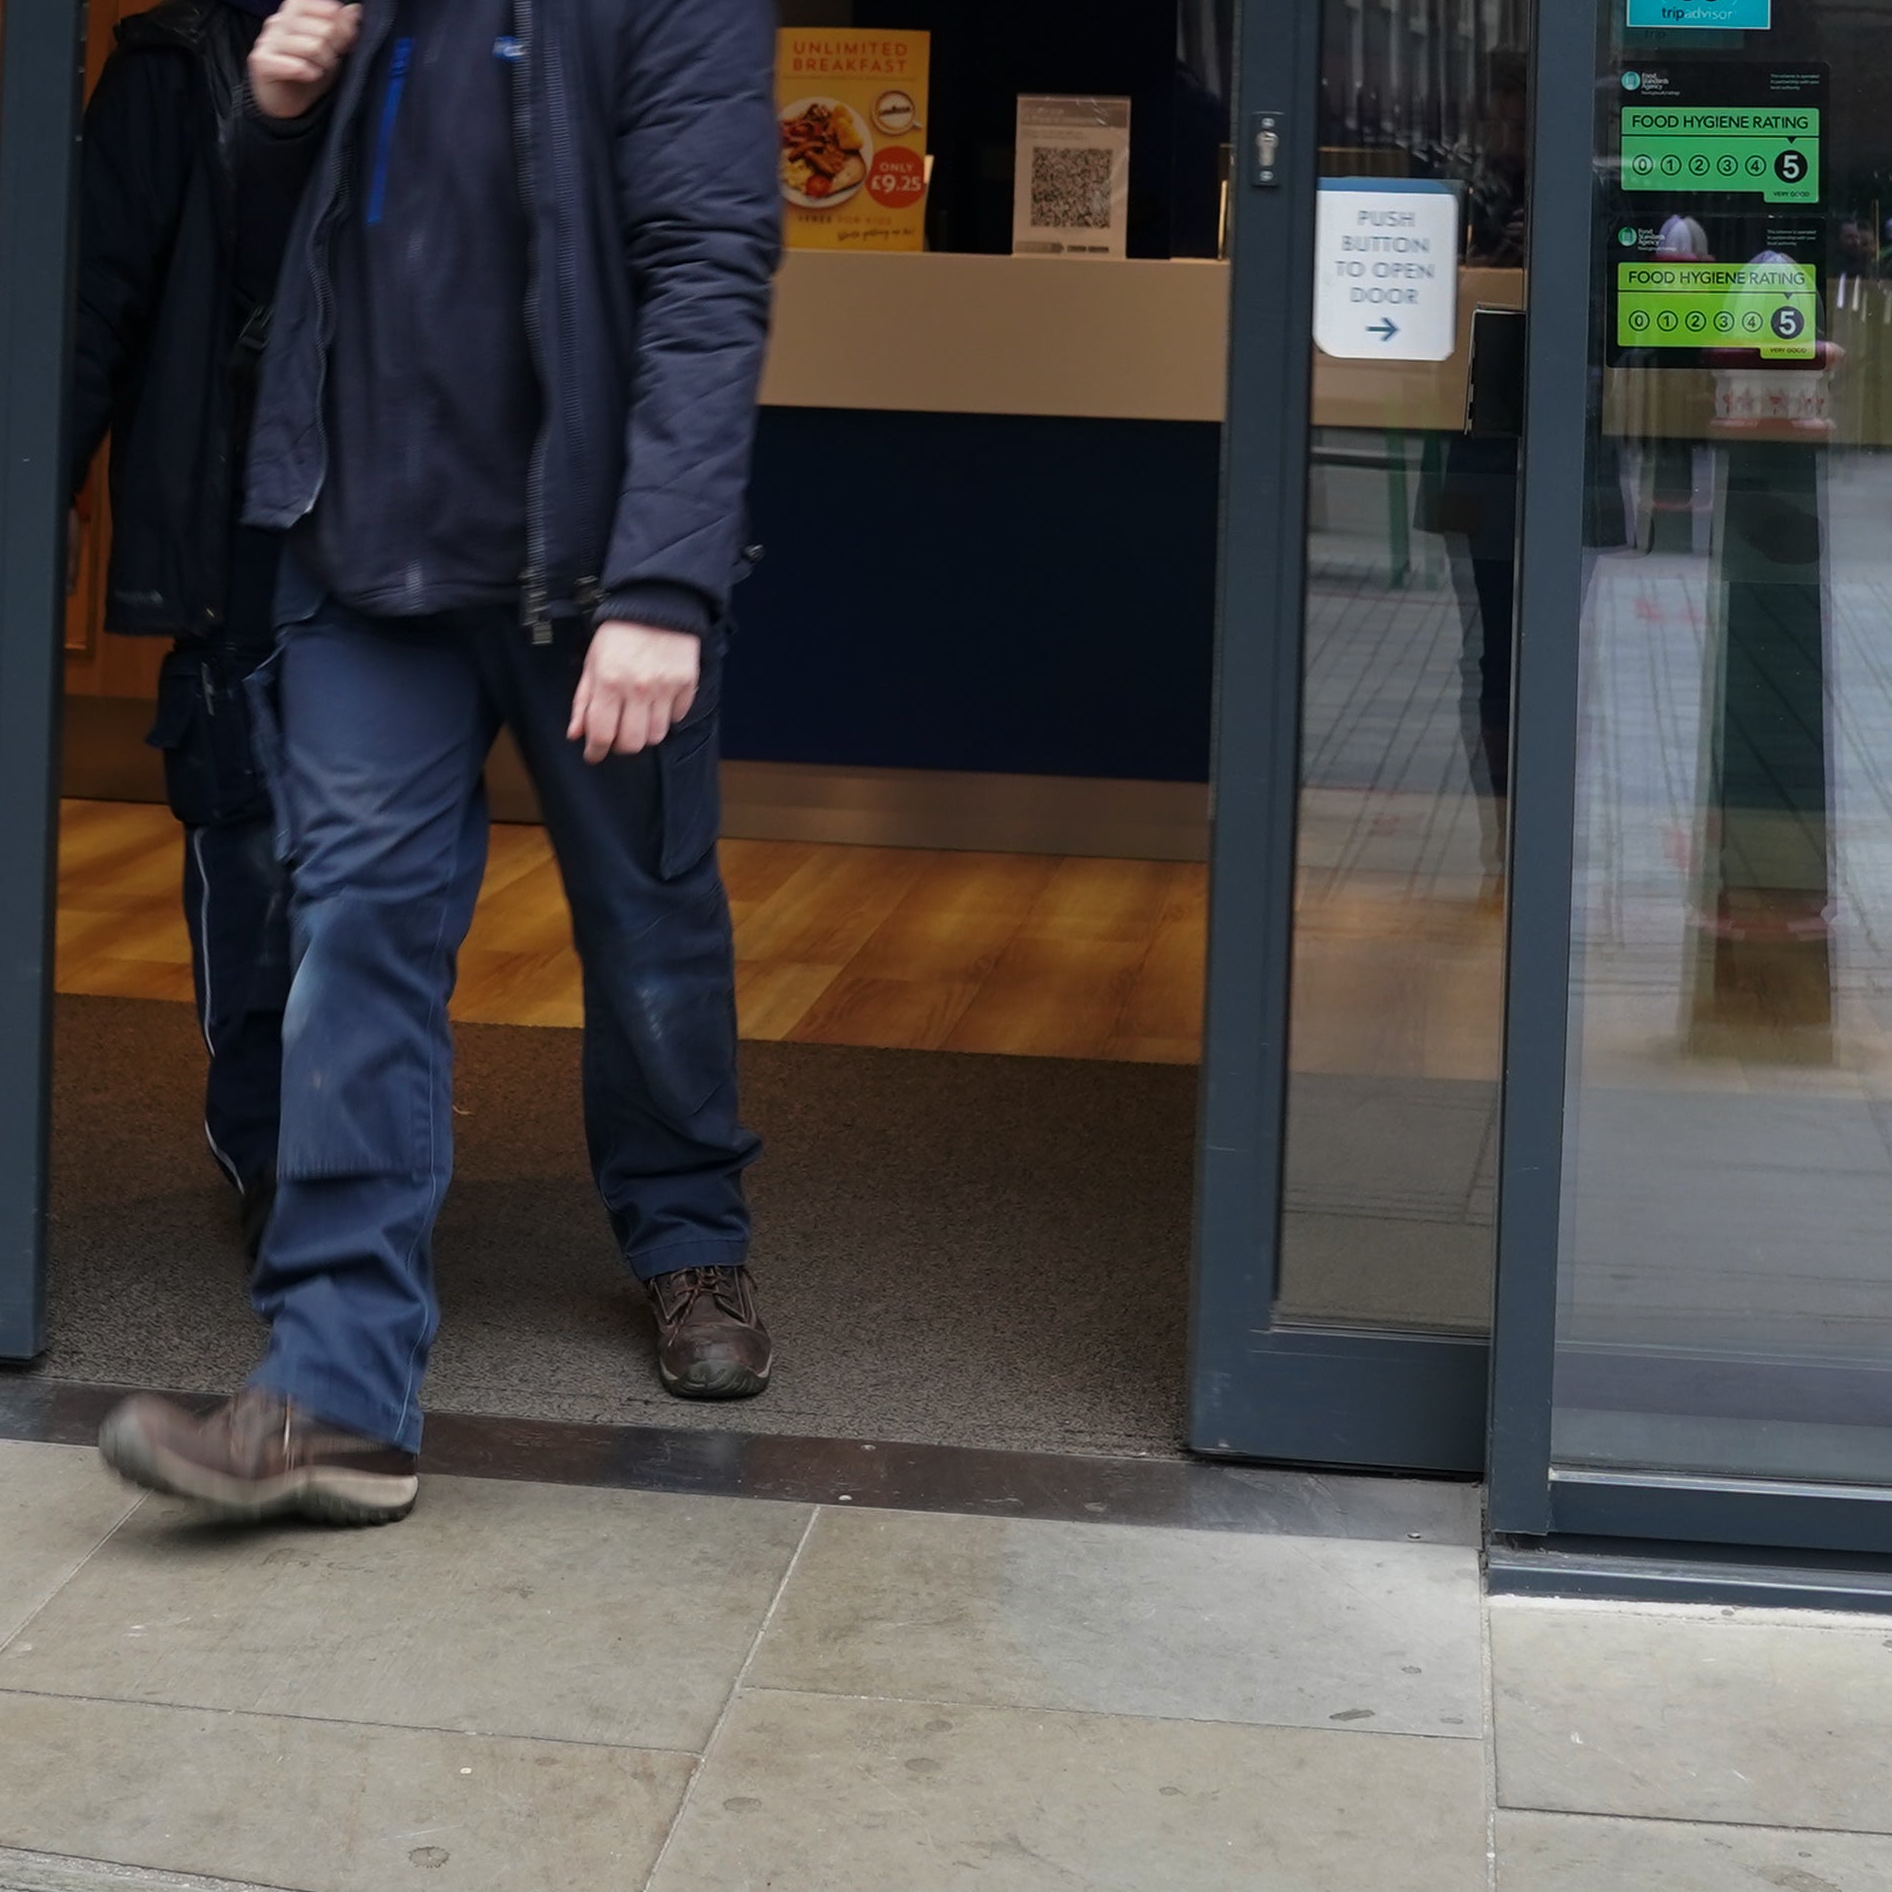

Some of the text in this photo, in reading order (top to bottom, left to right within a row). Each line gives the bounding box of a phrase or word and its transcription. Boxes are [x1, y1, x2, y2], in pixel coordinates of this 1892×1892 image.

[1661, 6, 1733, 21] tripadvisor
[793, 41, 909, 56] UNLIMITED
[793, 58, 907, 74] BREAKFAST
[1632, 115, 1809, 129] FOOD HYGIENE RATING
[879, 162, 914, 173] ONLY
[1639, 155, 1800, 179] 0 1 2 3 4 5
[871, 174, 922, 193] £9.25
[1357, 210, 1415, 227] PUSH
[1342, 235, 1430, 253] BUTTON
[1335, 261, 1435, 279] TO OPEN
[1629, 271, 1805, 285] FOOD HYGIENE RATING
[1350, 287, 1419, 304] DOOR
[1635, 311, 1797, 335] 0 1 2 3 4 5
